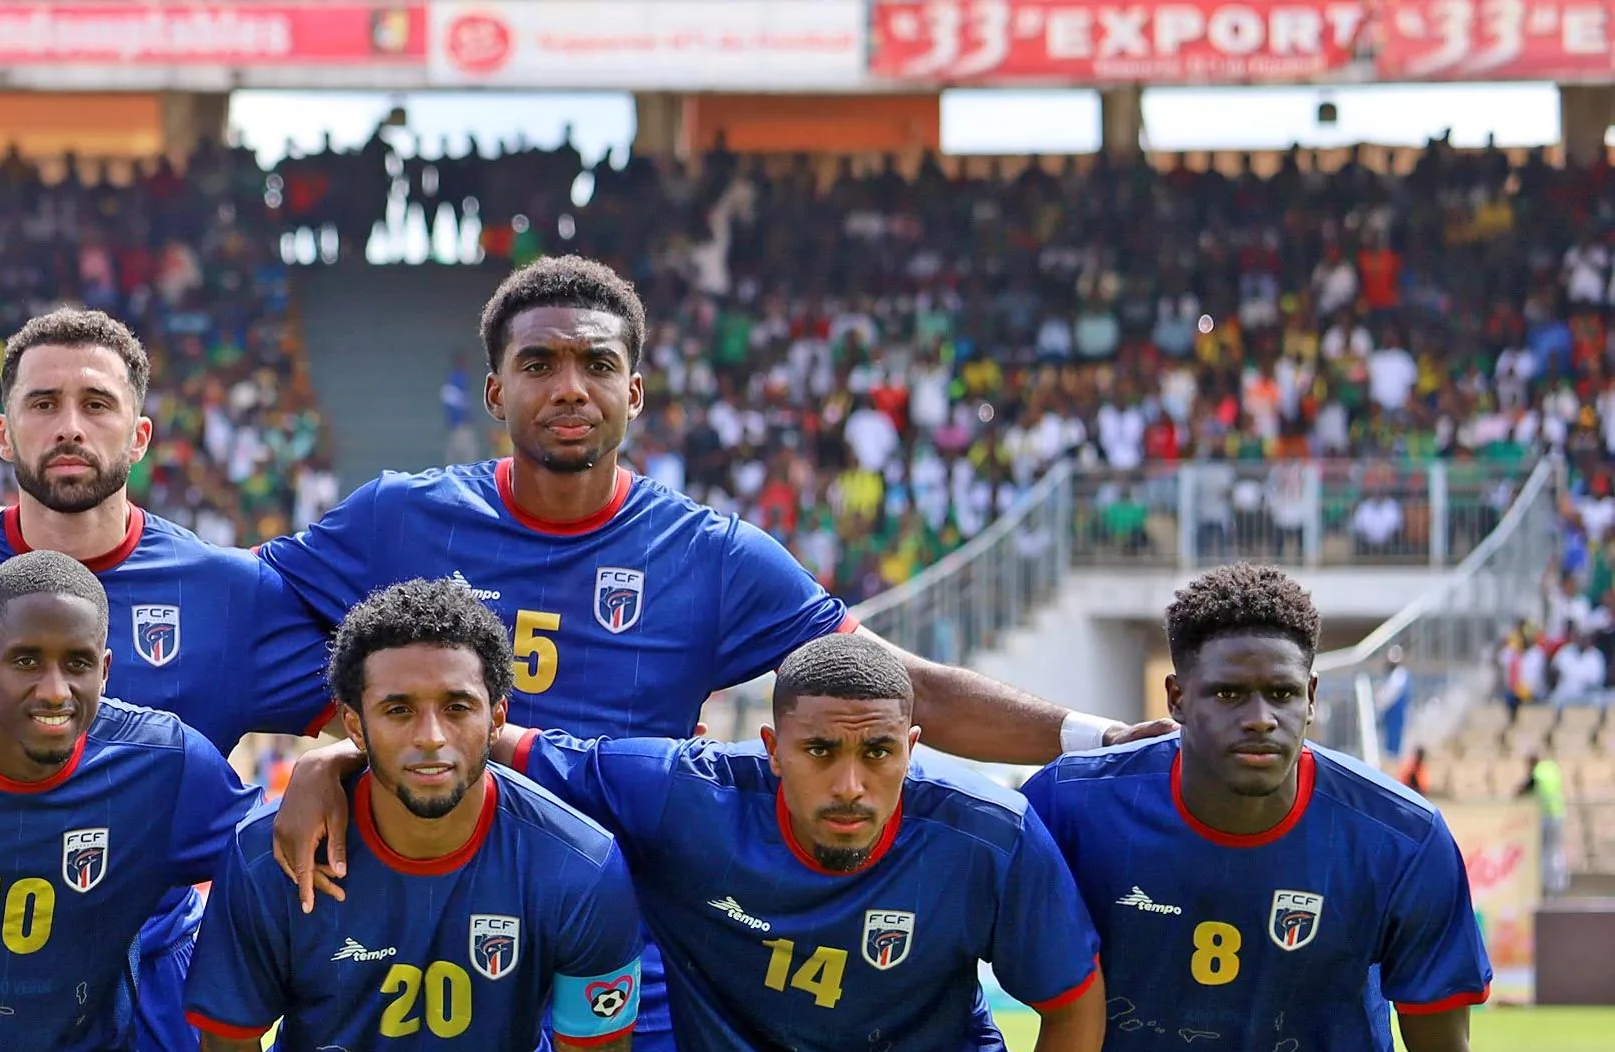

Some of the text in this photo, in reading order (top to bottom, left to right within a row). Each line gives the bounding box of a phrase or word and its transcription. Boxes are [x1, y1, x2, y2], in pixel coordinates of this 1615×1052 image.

[600, 571, 639, 584] FCF
[136, 607, 175, 618] FCF
[512, 609, 561, 694] 5
[67, 832, 105, 845] FCF
[1277, 894, 1318, 906] FCF
[1138, 901, 1182, 915] tempo
[474, 919, 515, 930] FCF
[727, 908, 771, 932] tempo
[869, 913, 910, 925] FCF
[352, 945, 397, 962] tempo
[1190, 920, 1242, 986] 8
[762, 938, 849, 1009] 14
[379, 960, 472, 1038] 20
